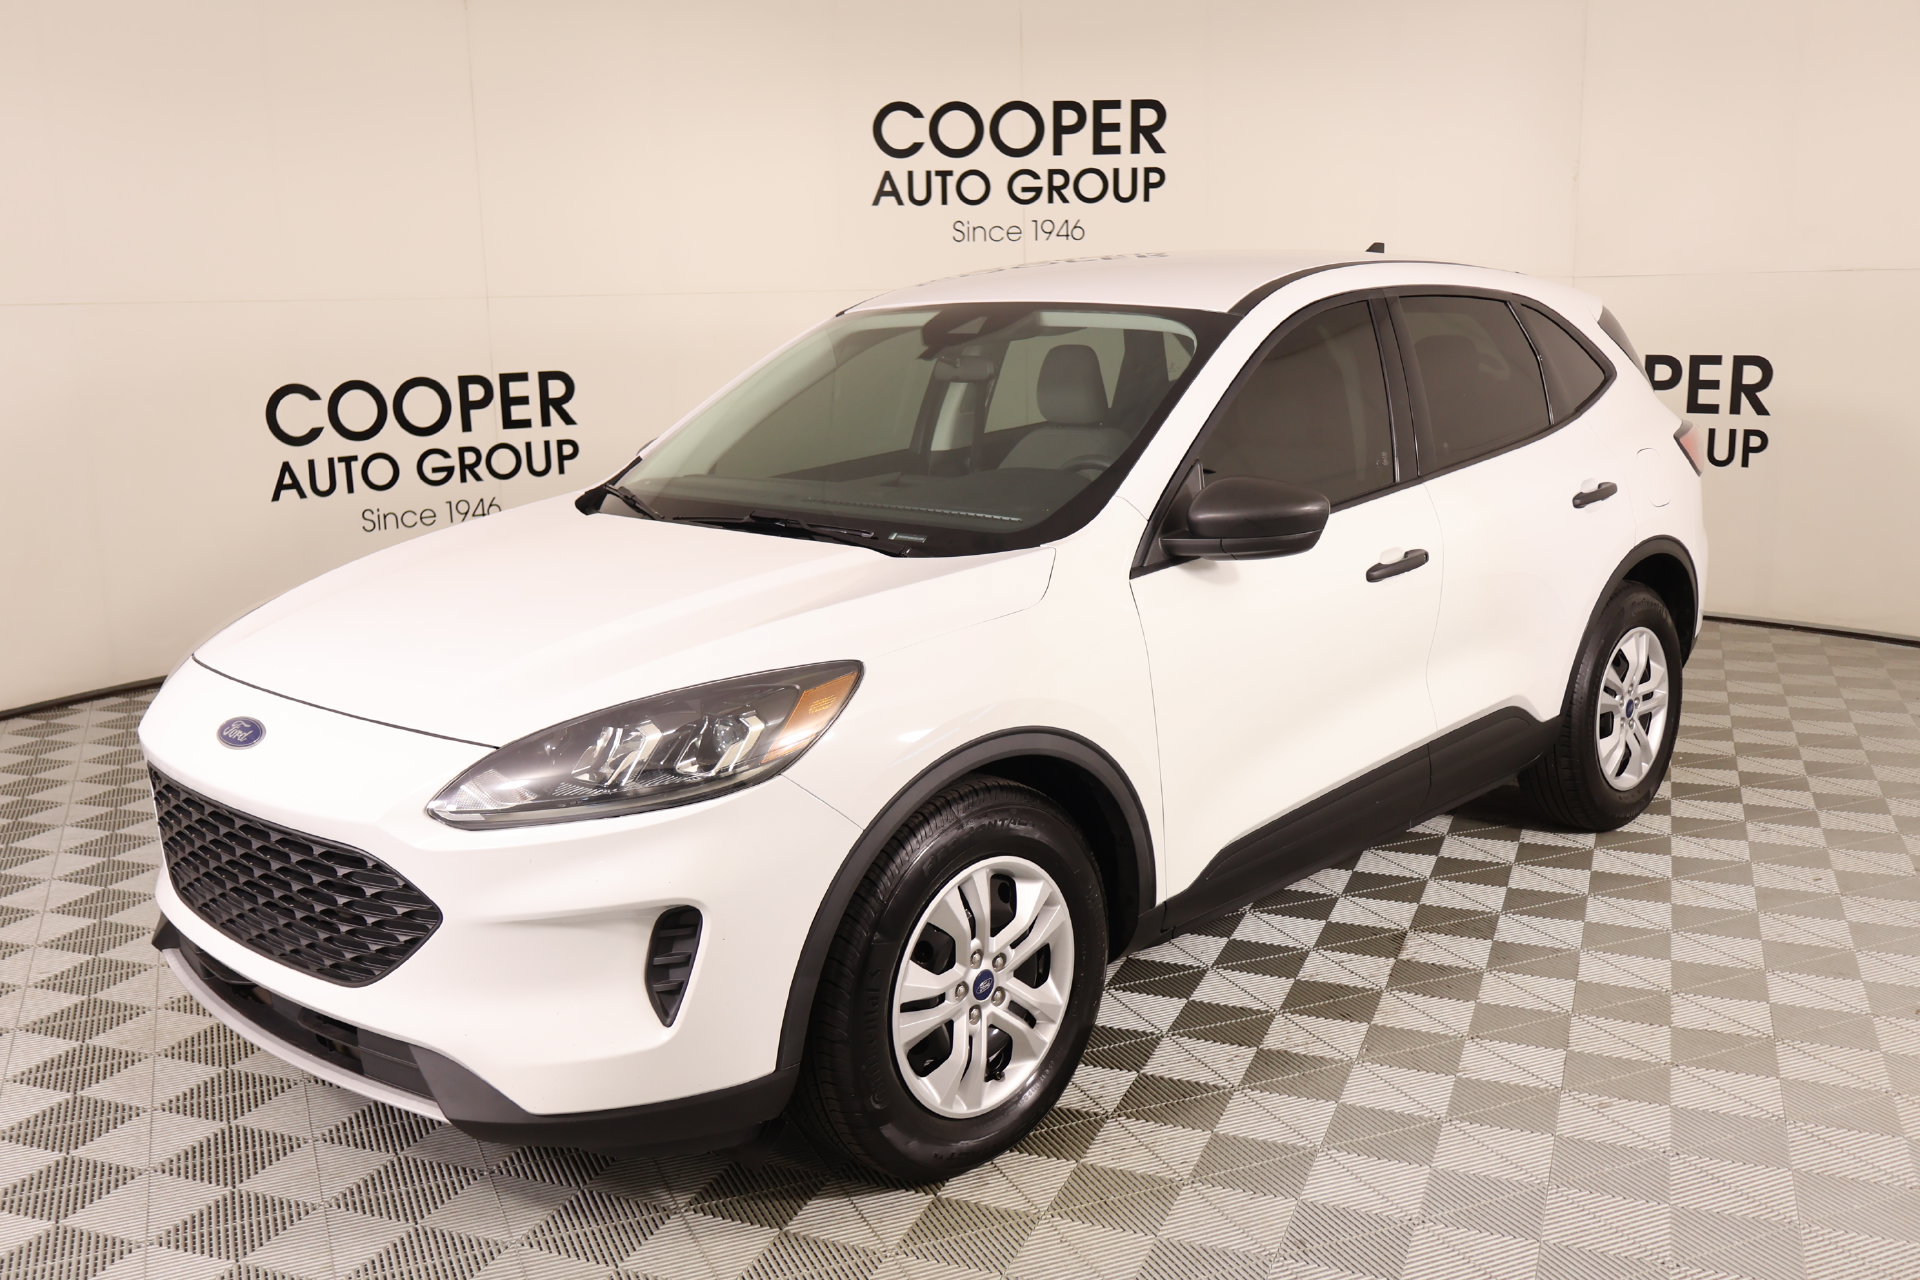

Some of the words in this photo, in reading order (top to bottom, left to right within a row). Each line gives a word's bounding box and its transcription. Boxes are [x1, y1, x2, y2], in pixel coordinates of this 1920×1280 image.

[873, 99, 1167, 158] COOPER
[872, 169, 991, 206] AUTO
[1007, 167, 1166, 205] GROUP
[952, 220, 1022, 242] Since
[1031, 219, 1085, 241] 1946
[266, 370, 577, 447] COOPER
[271, 452, 400, 502] AUTO
[416, 439, 580, 486] GROUP
[361, 508, 437, 533] Since
[222, 720, 254, 742] Ford
